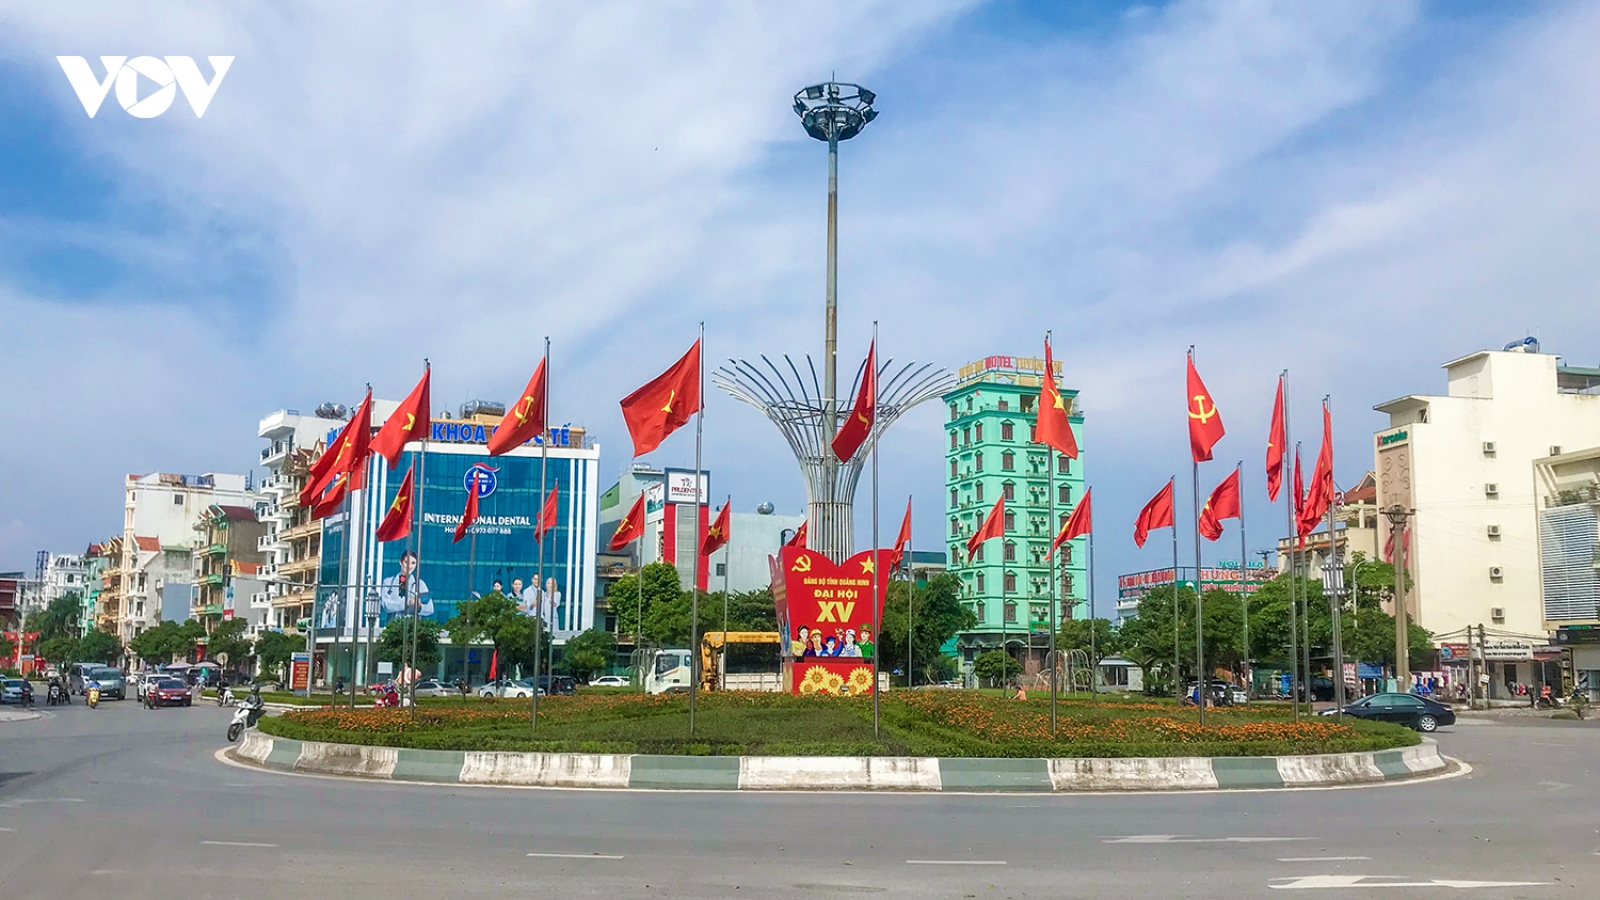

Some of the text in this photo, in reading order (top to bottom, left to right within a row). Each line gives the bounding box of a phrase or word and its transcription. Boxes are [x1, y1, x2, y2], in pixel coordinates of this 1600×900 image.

[433, 422, 485, 442] KHOA
[551, 422, 572, 446] TẾ
[424, 513, 531, 526] INTERNAONAL DENTAL
[814, 588, 858, 601] ĐẠI HỘI
[816, 601, 856, 623] XV
